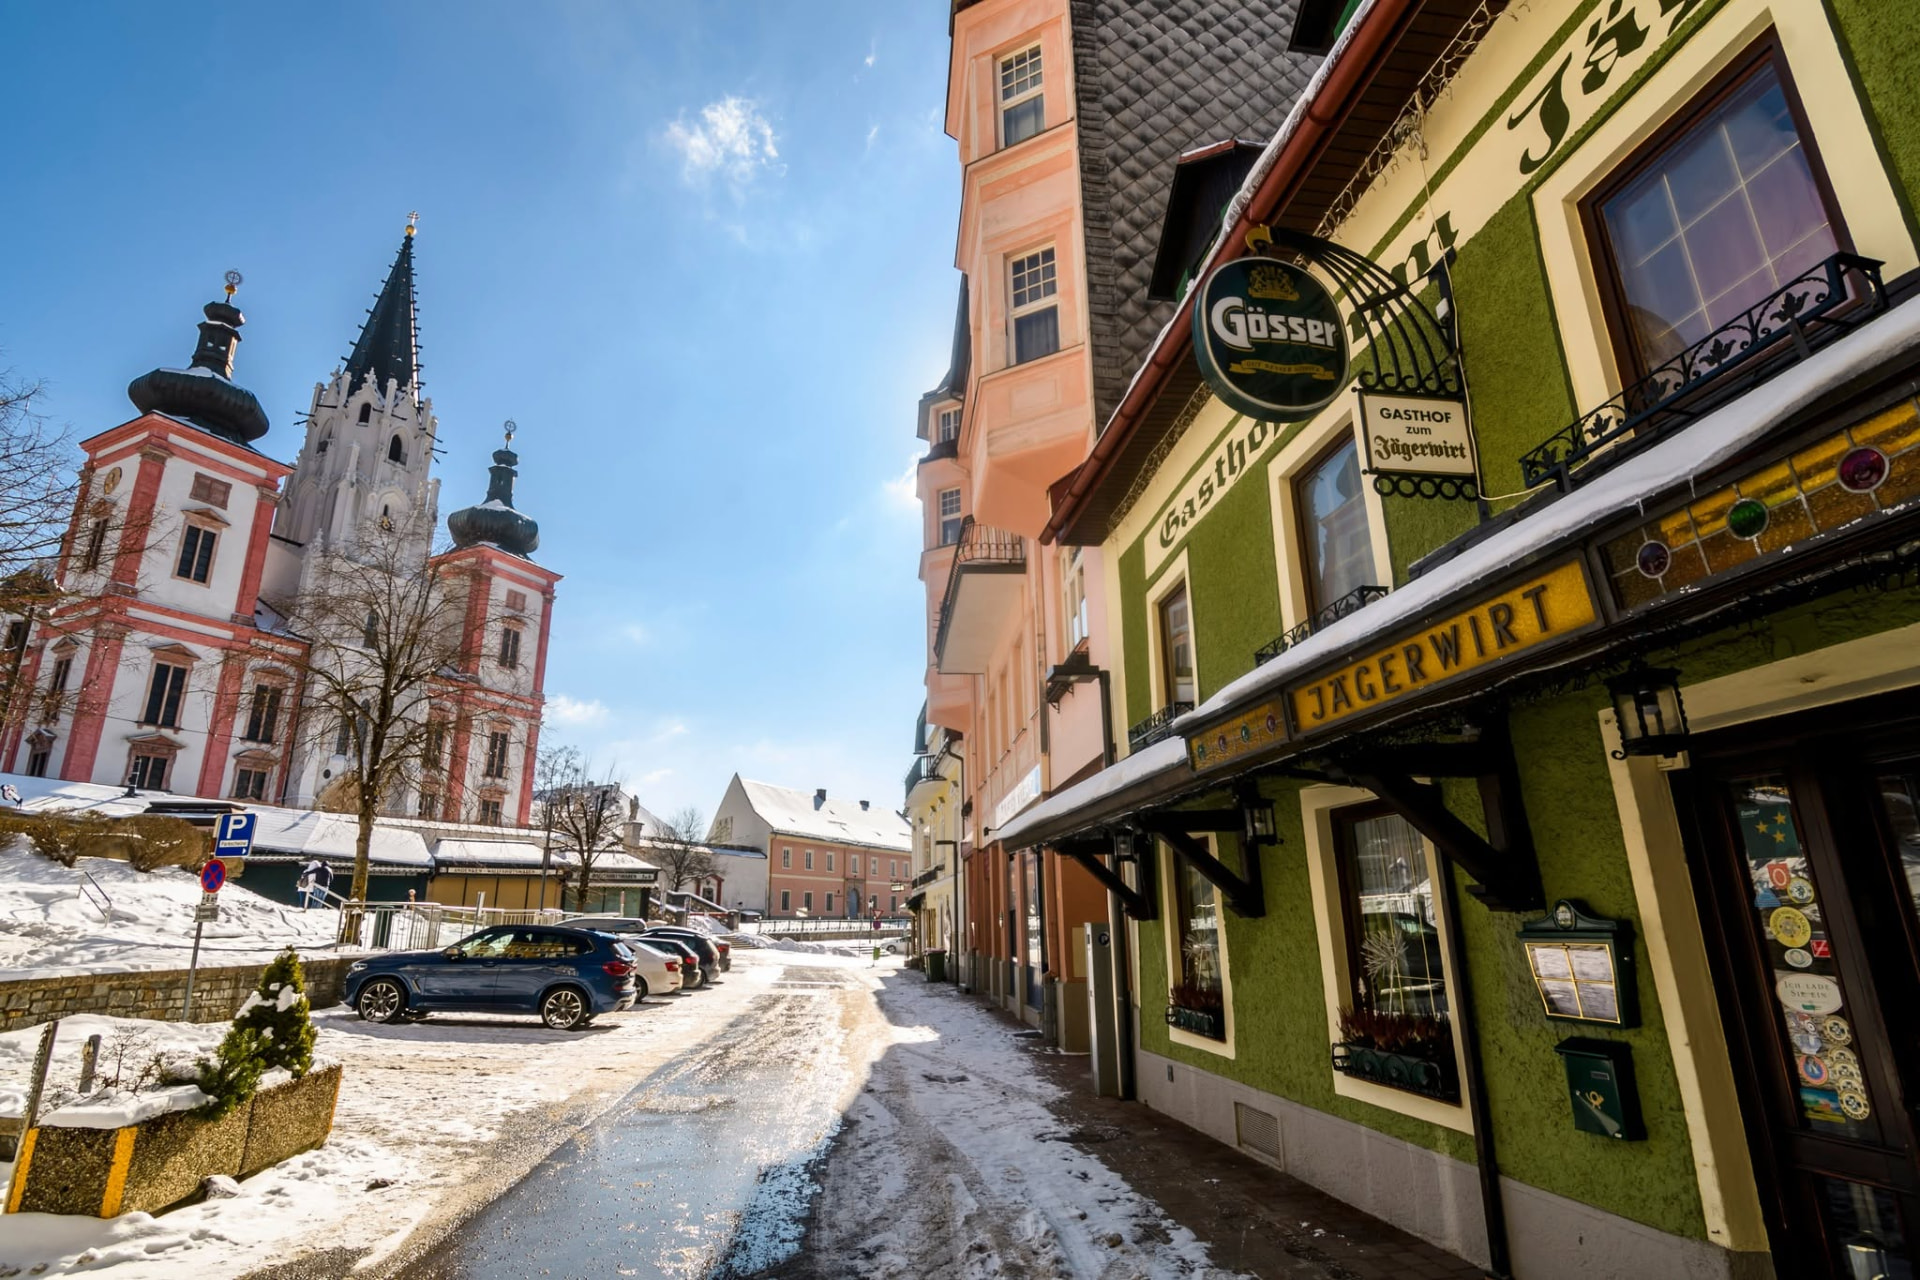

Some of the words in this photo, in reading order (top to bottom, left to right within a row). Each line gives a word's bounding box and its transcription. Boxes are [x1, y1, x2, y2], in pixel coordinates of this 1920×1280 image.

[1211, 296, 1337, 348] Gösser
[1379, 407, 1452, 423] GASTHOF
[1405, 426, 1432, 435] zum
[1374, 435, 1467, 462] Jägerwirt
[1160, 419, 1285, 548] Gastho
[1307, 584, 1550, 720] JÄGERWIRT
[226, 815, 247, 839] P
